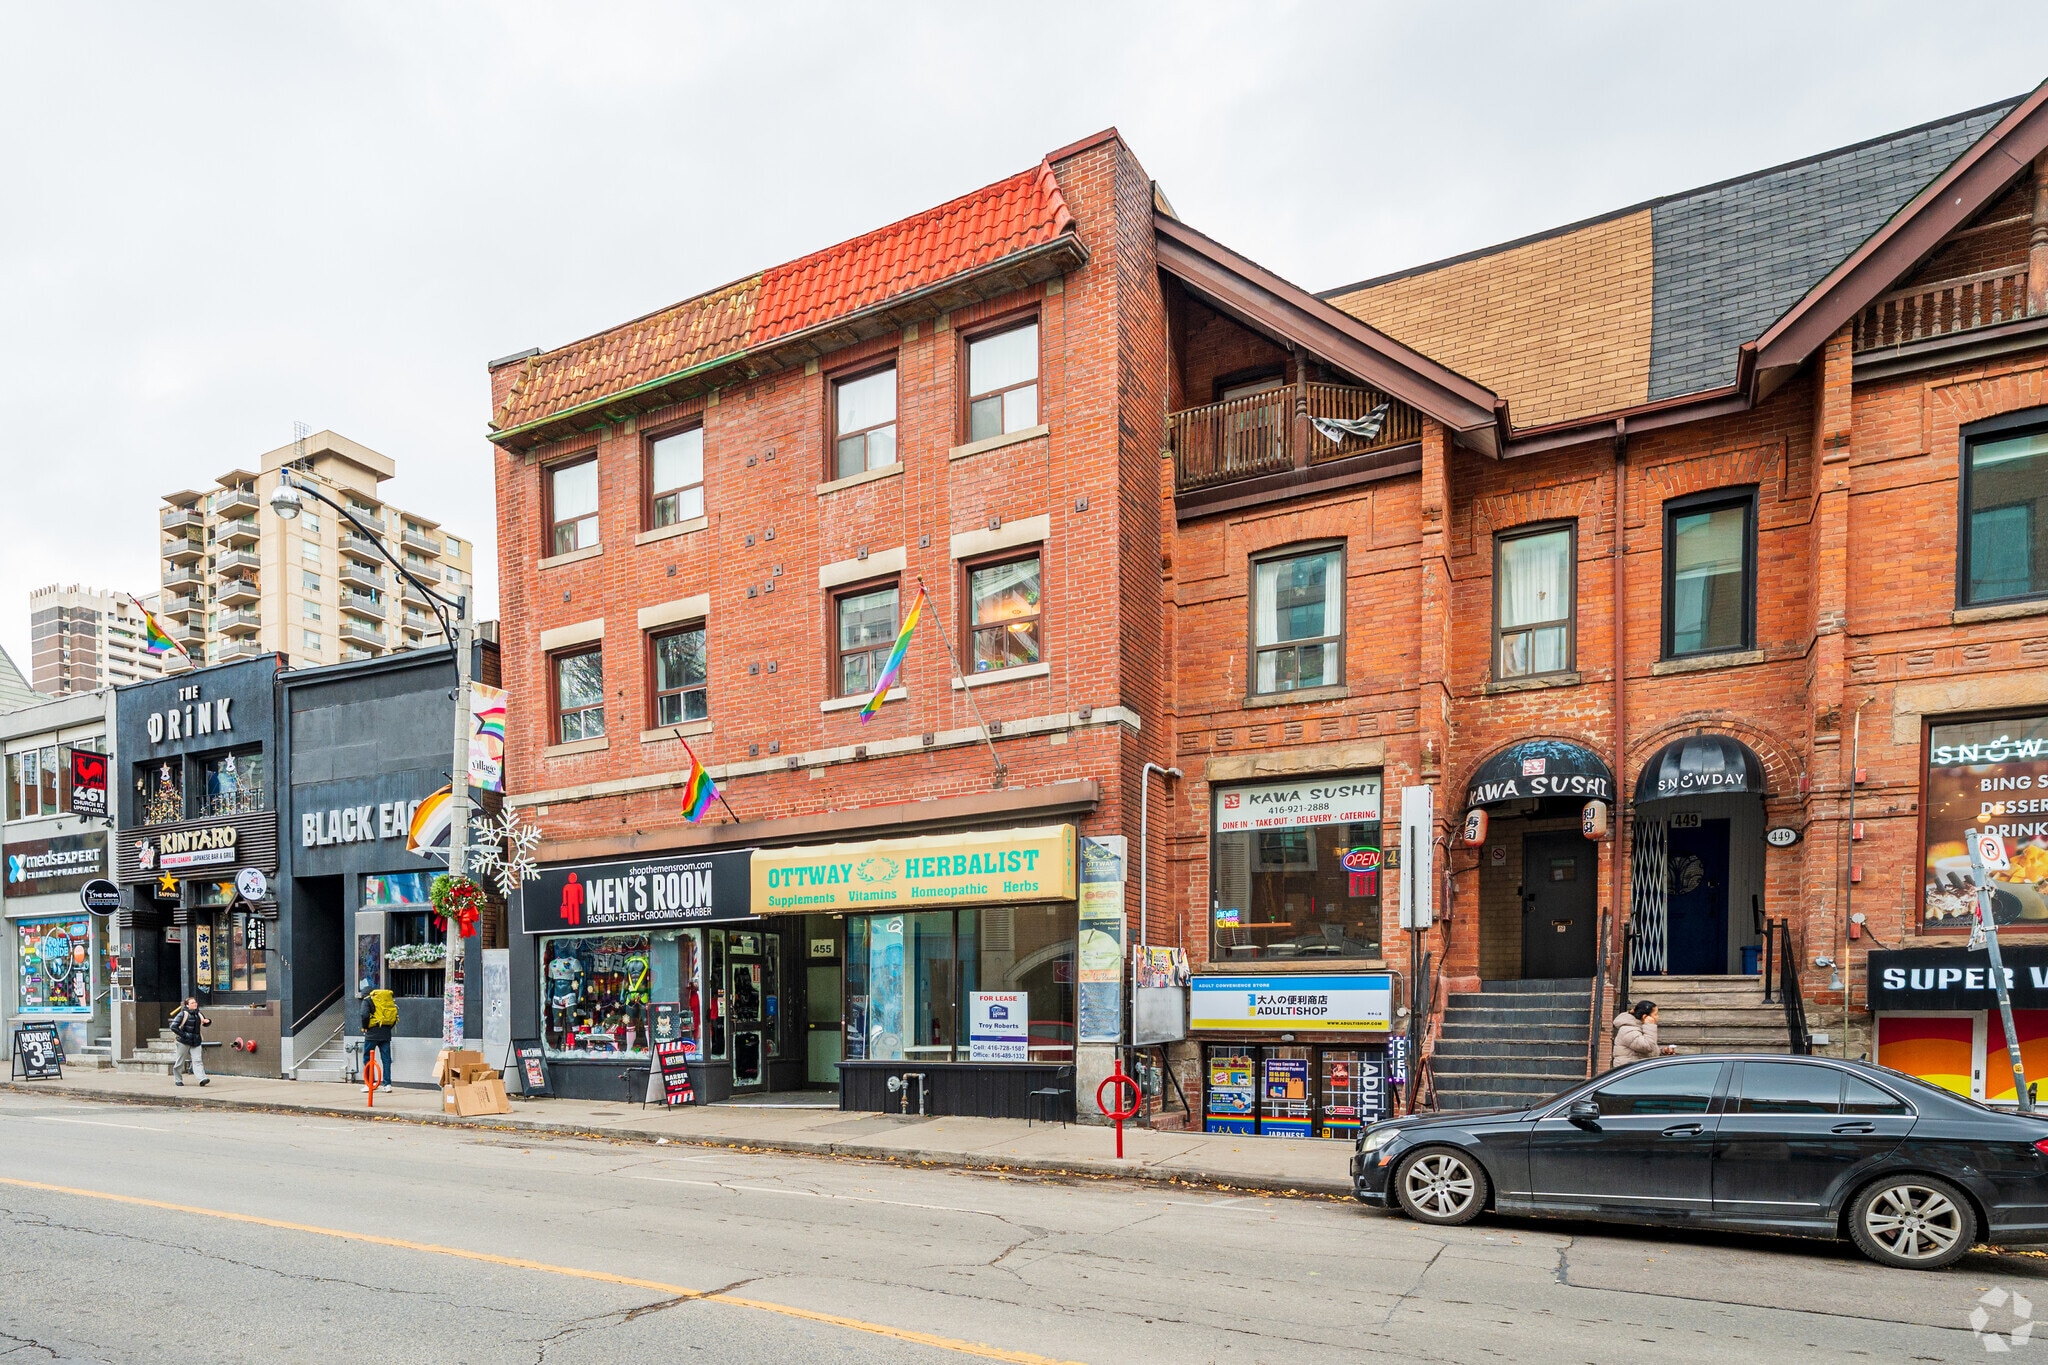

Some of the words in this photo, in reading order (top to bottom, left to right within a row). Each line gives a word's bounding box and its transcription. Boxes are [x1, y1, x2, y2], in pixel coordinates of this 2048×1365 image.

[179, 685, 199, 701] THE
[1468, 780, 1519, 806] KAWA
[1530, 776, 1607, 797] SUSHI
[1980, 776, 2032, 792] BING
[73, 786, 105, 803] 461
[1249, 792, 1301, 805] KAWA
[1309, 783, 1377, 799] SUSHI
[73, 798, 96, 808] CHURCH
[1268, 803, 1330, 815] 416-921-2888
[302, 804, 375, 847] BLACK
[1222, 821, 1239, 830] DINE
[1240, 821, 1248, 829] IN
[1255, 818, 1272, 827] TAKE
[1273, 817, 1288, 826] OUT
[1296, 814, 1332, 824] DELEVERY
[1340, 810, 1376, 821] CATERING
[1674, 814, 1699, 827] 449
[160, 826, 237, 854] KINTARO
[1771, 831, 1791, 841] 449
[1086, 860, 1114, 868] OTTWAY
[1345, 853, 1379, 866] OPEN
[629, 861, 713, 877] shopthemensroom.com
[768, 863, 853, 889] OTTWAY
[905, 849, 1040, 879] HERBALIST
[586, 875, 648, 915] MEN'S
[653, 869, 713, 909] ROOM
[768, 891, 836, 907] Supplements
[848, 888, 898, 902] Vitamins
[911, 883, 989, 898] Homeopathic
[1003, 880, 1040, 893] Herbs
[587, 913, 615, 924] FASHION
[619, 911, 640, 921] FETISH
[645, 909, 683, 920] GROOMING
[685, 906, 713, 917] BARBER
[47, 938, 68, 947] COME
[813, 944, 831, 953] 455
[46, 947, 69, 957] INSIDE
[1883, 968, 2015, 990] SUPER
[1257, 995, 1328, 1005] 大人の便利商店
[1257, 1006, 1328, 1016] ADULTISHOP
[979, 1022, 992, 1030] Troy
[21, 1032, 51, 1042] MONDAY
[665, 1073, 688, 1081] BARBER
